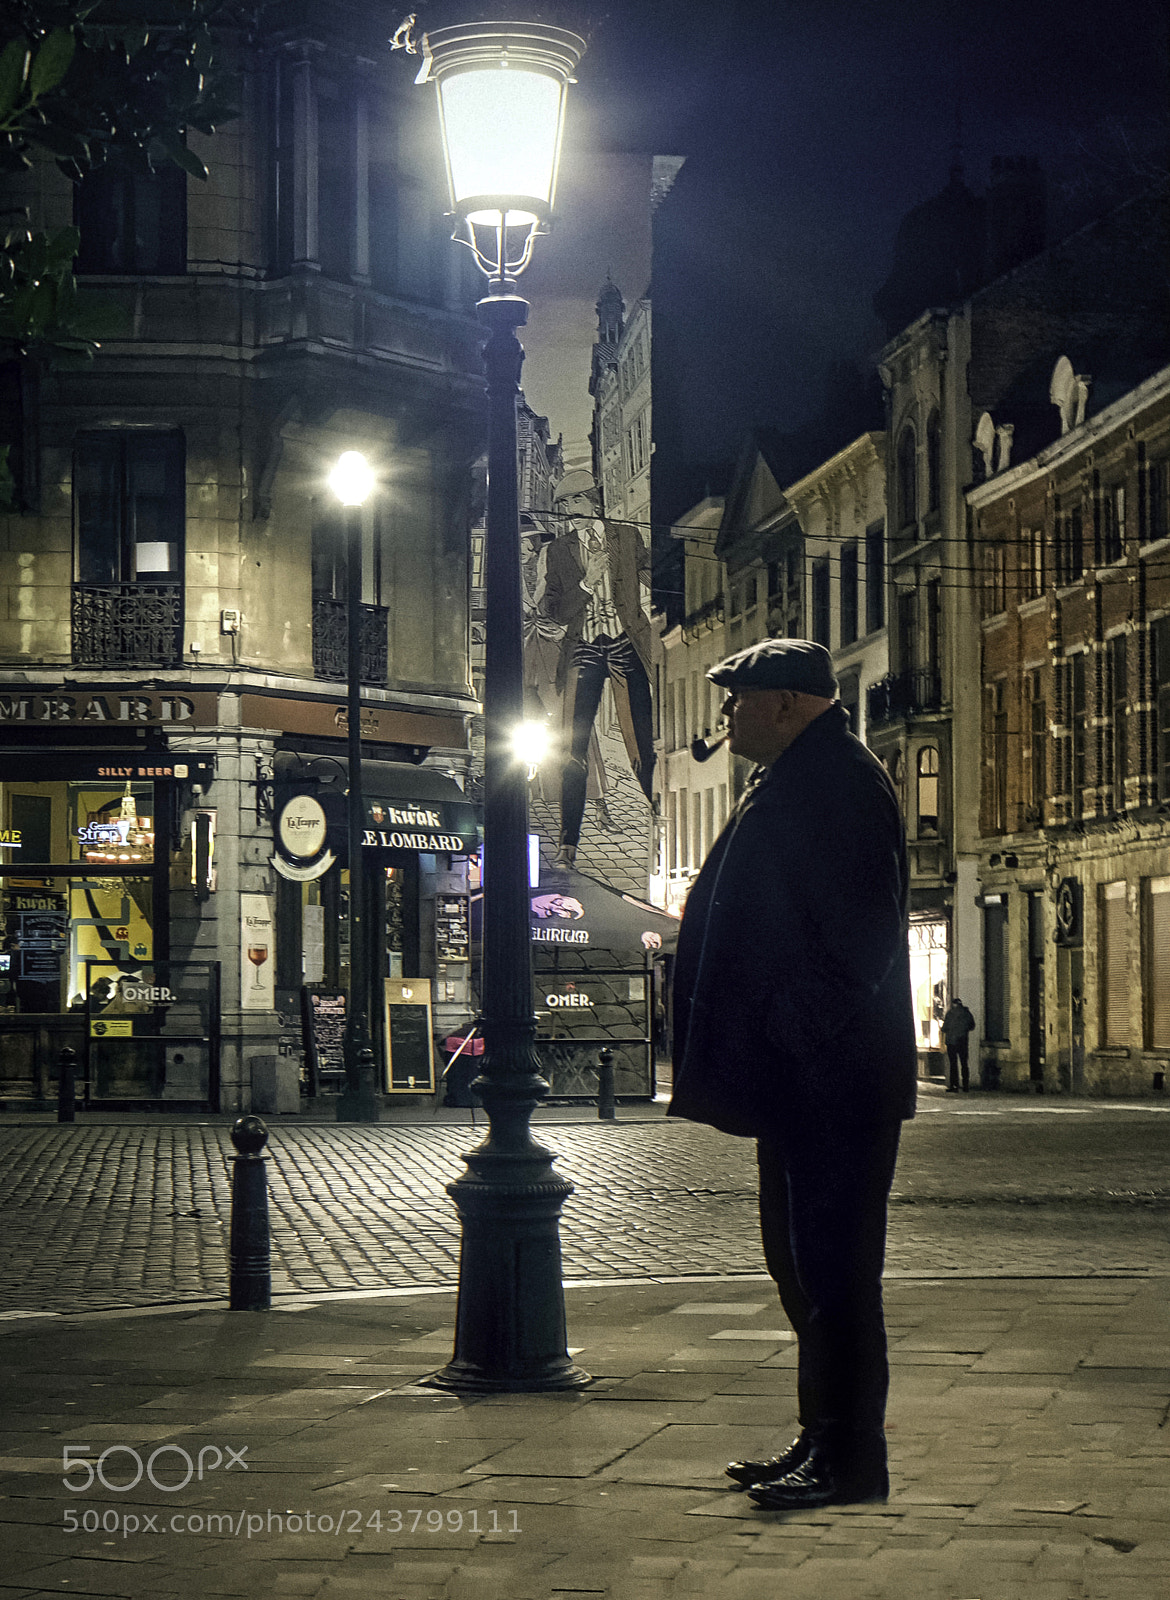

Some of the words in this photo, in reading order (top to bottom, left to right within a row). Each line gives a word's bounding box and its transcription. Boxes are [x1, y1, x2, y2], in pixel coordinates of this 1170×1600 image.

[0, 695, 195, 721] MBARD
[97, 767, 133, 777] SILLY
[138, 767, 173, 777] BEER
[379, 831, 464, 851] LOMBARD
